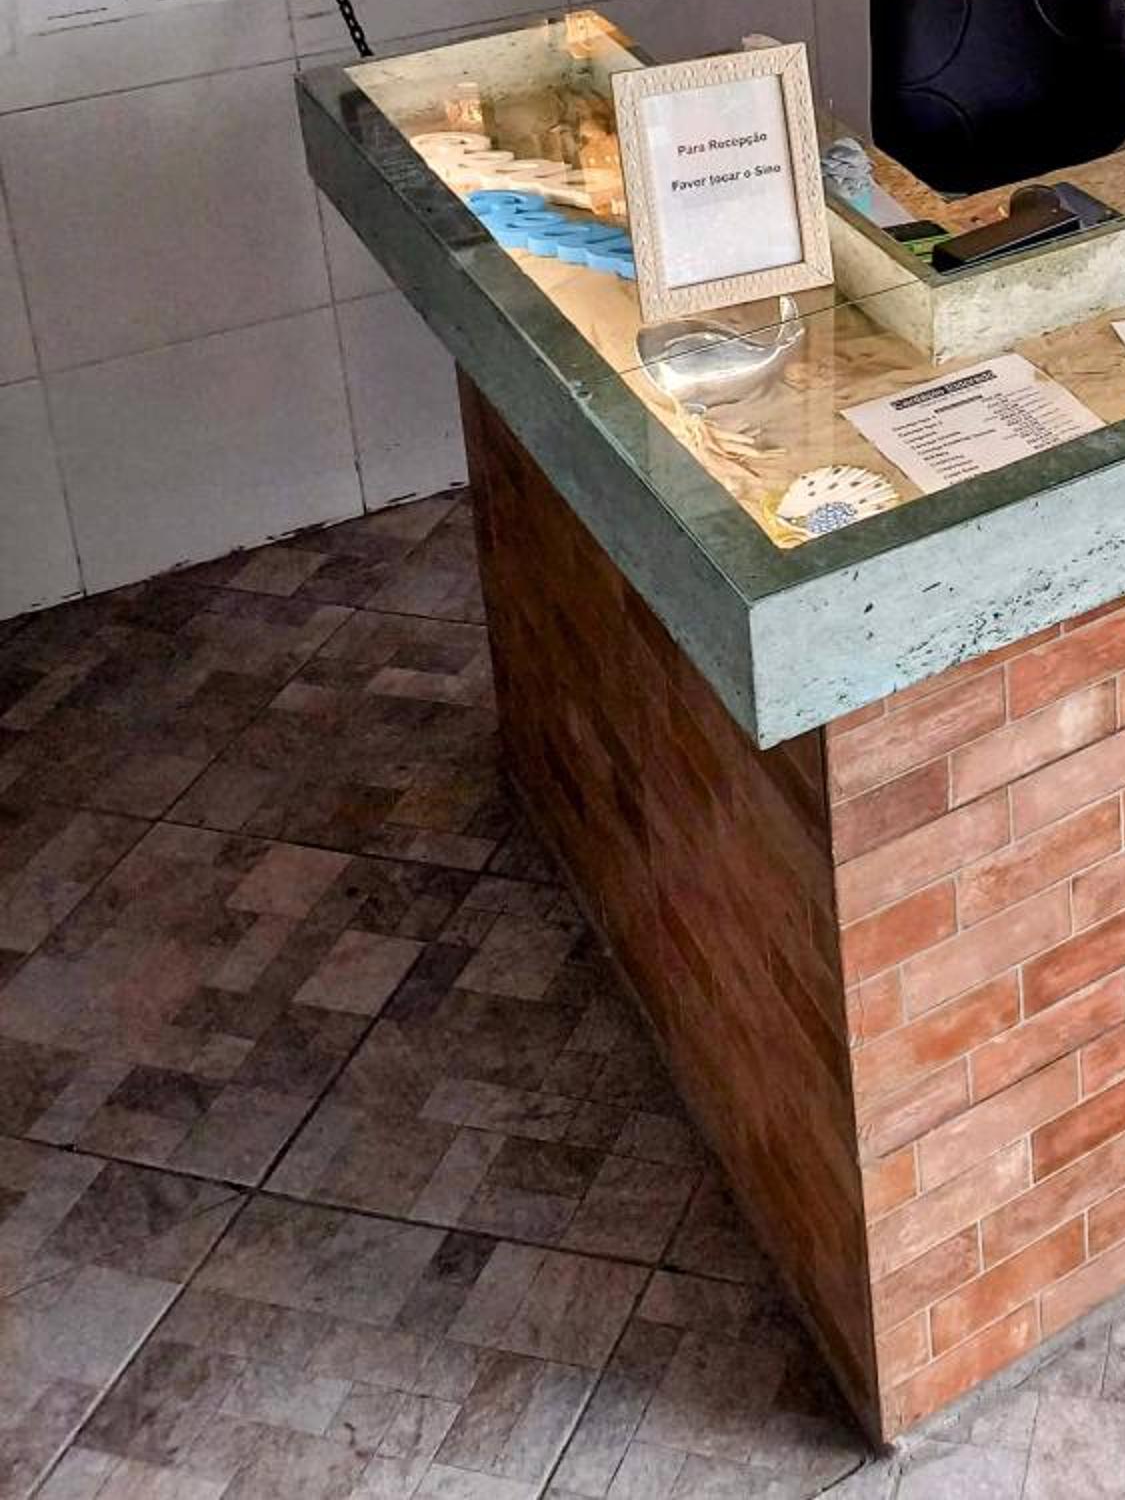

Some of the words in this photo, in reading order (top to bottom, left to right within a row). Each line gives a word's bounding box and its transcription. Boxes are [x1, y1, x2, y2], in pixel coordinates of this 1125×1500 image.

[678, 143, 705, 157] Para
[709, 131, 768, 151] Recepção
[672, 178, 707, 192] Favor
[709, 171, 741, 186] tocar
[744, 171, 752, 179] o
[755, 163, 782, 177] Sino
